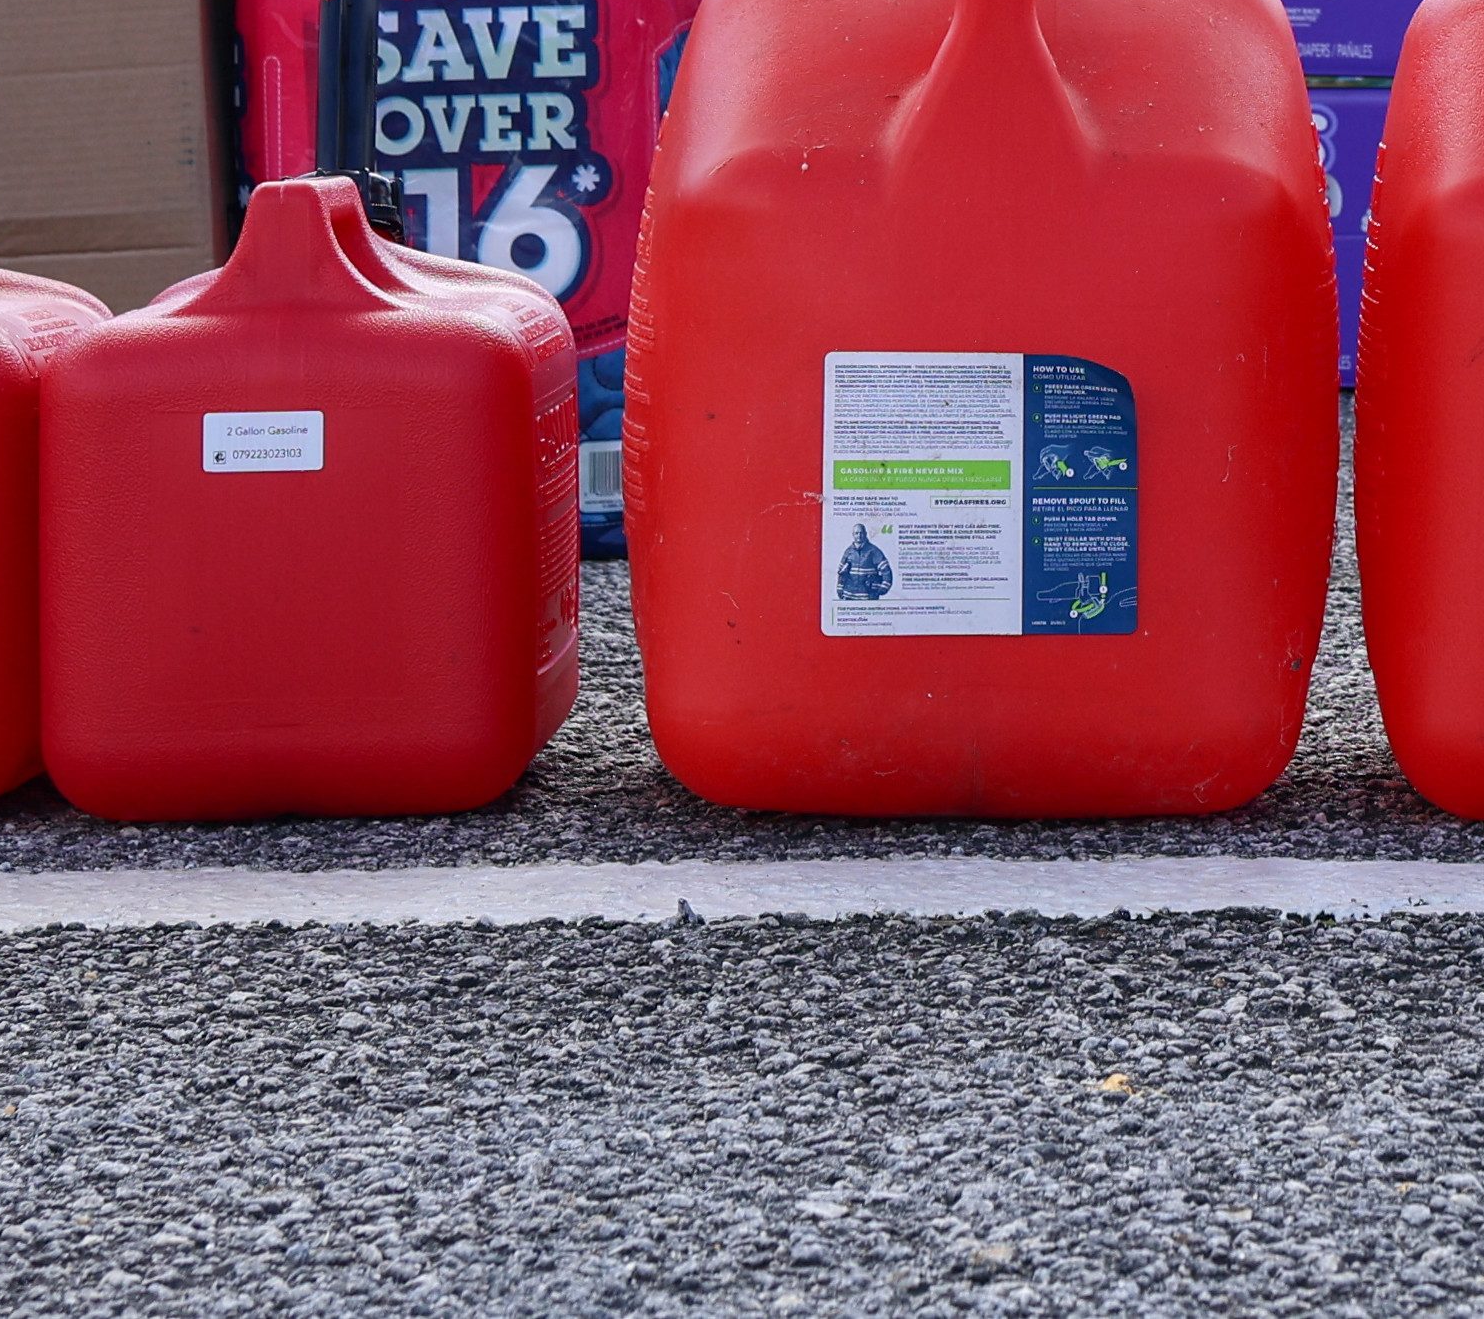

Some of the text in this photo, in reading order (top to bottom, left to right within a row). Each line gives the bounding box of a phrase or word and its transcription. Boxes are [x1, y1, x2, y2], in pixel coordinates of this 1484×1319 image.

[377, 4, 587, 85] SAVE
[375, 91, 577, 156] OVER
[1032, 365, 1085, 375] HOW TO USE
[227, 424, 309, 436] 2 Gallon Gasoline
[232, 448, 302, 460] 079223023103
[840, 467, 884, 475] GASOLINE
[893, 467, 914, 475] FIRE
[915, 467, 946, 475] NEVER
[947, 467, 964, 475] MIX
[934, 498, 1007, 506] STOPGASFIRES.ORG
[1032, 497, 1067, 505] REMOVE
[1069, 497, 1096, 505] SPOUT
[1097, 497, 1109, 505] TO
